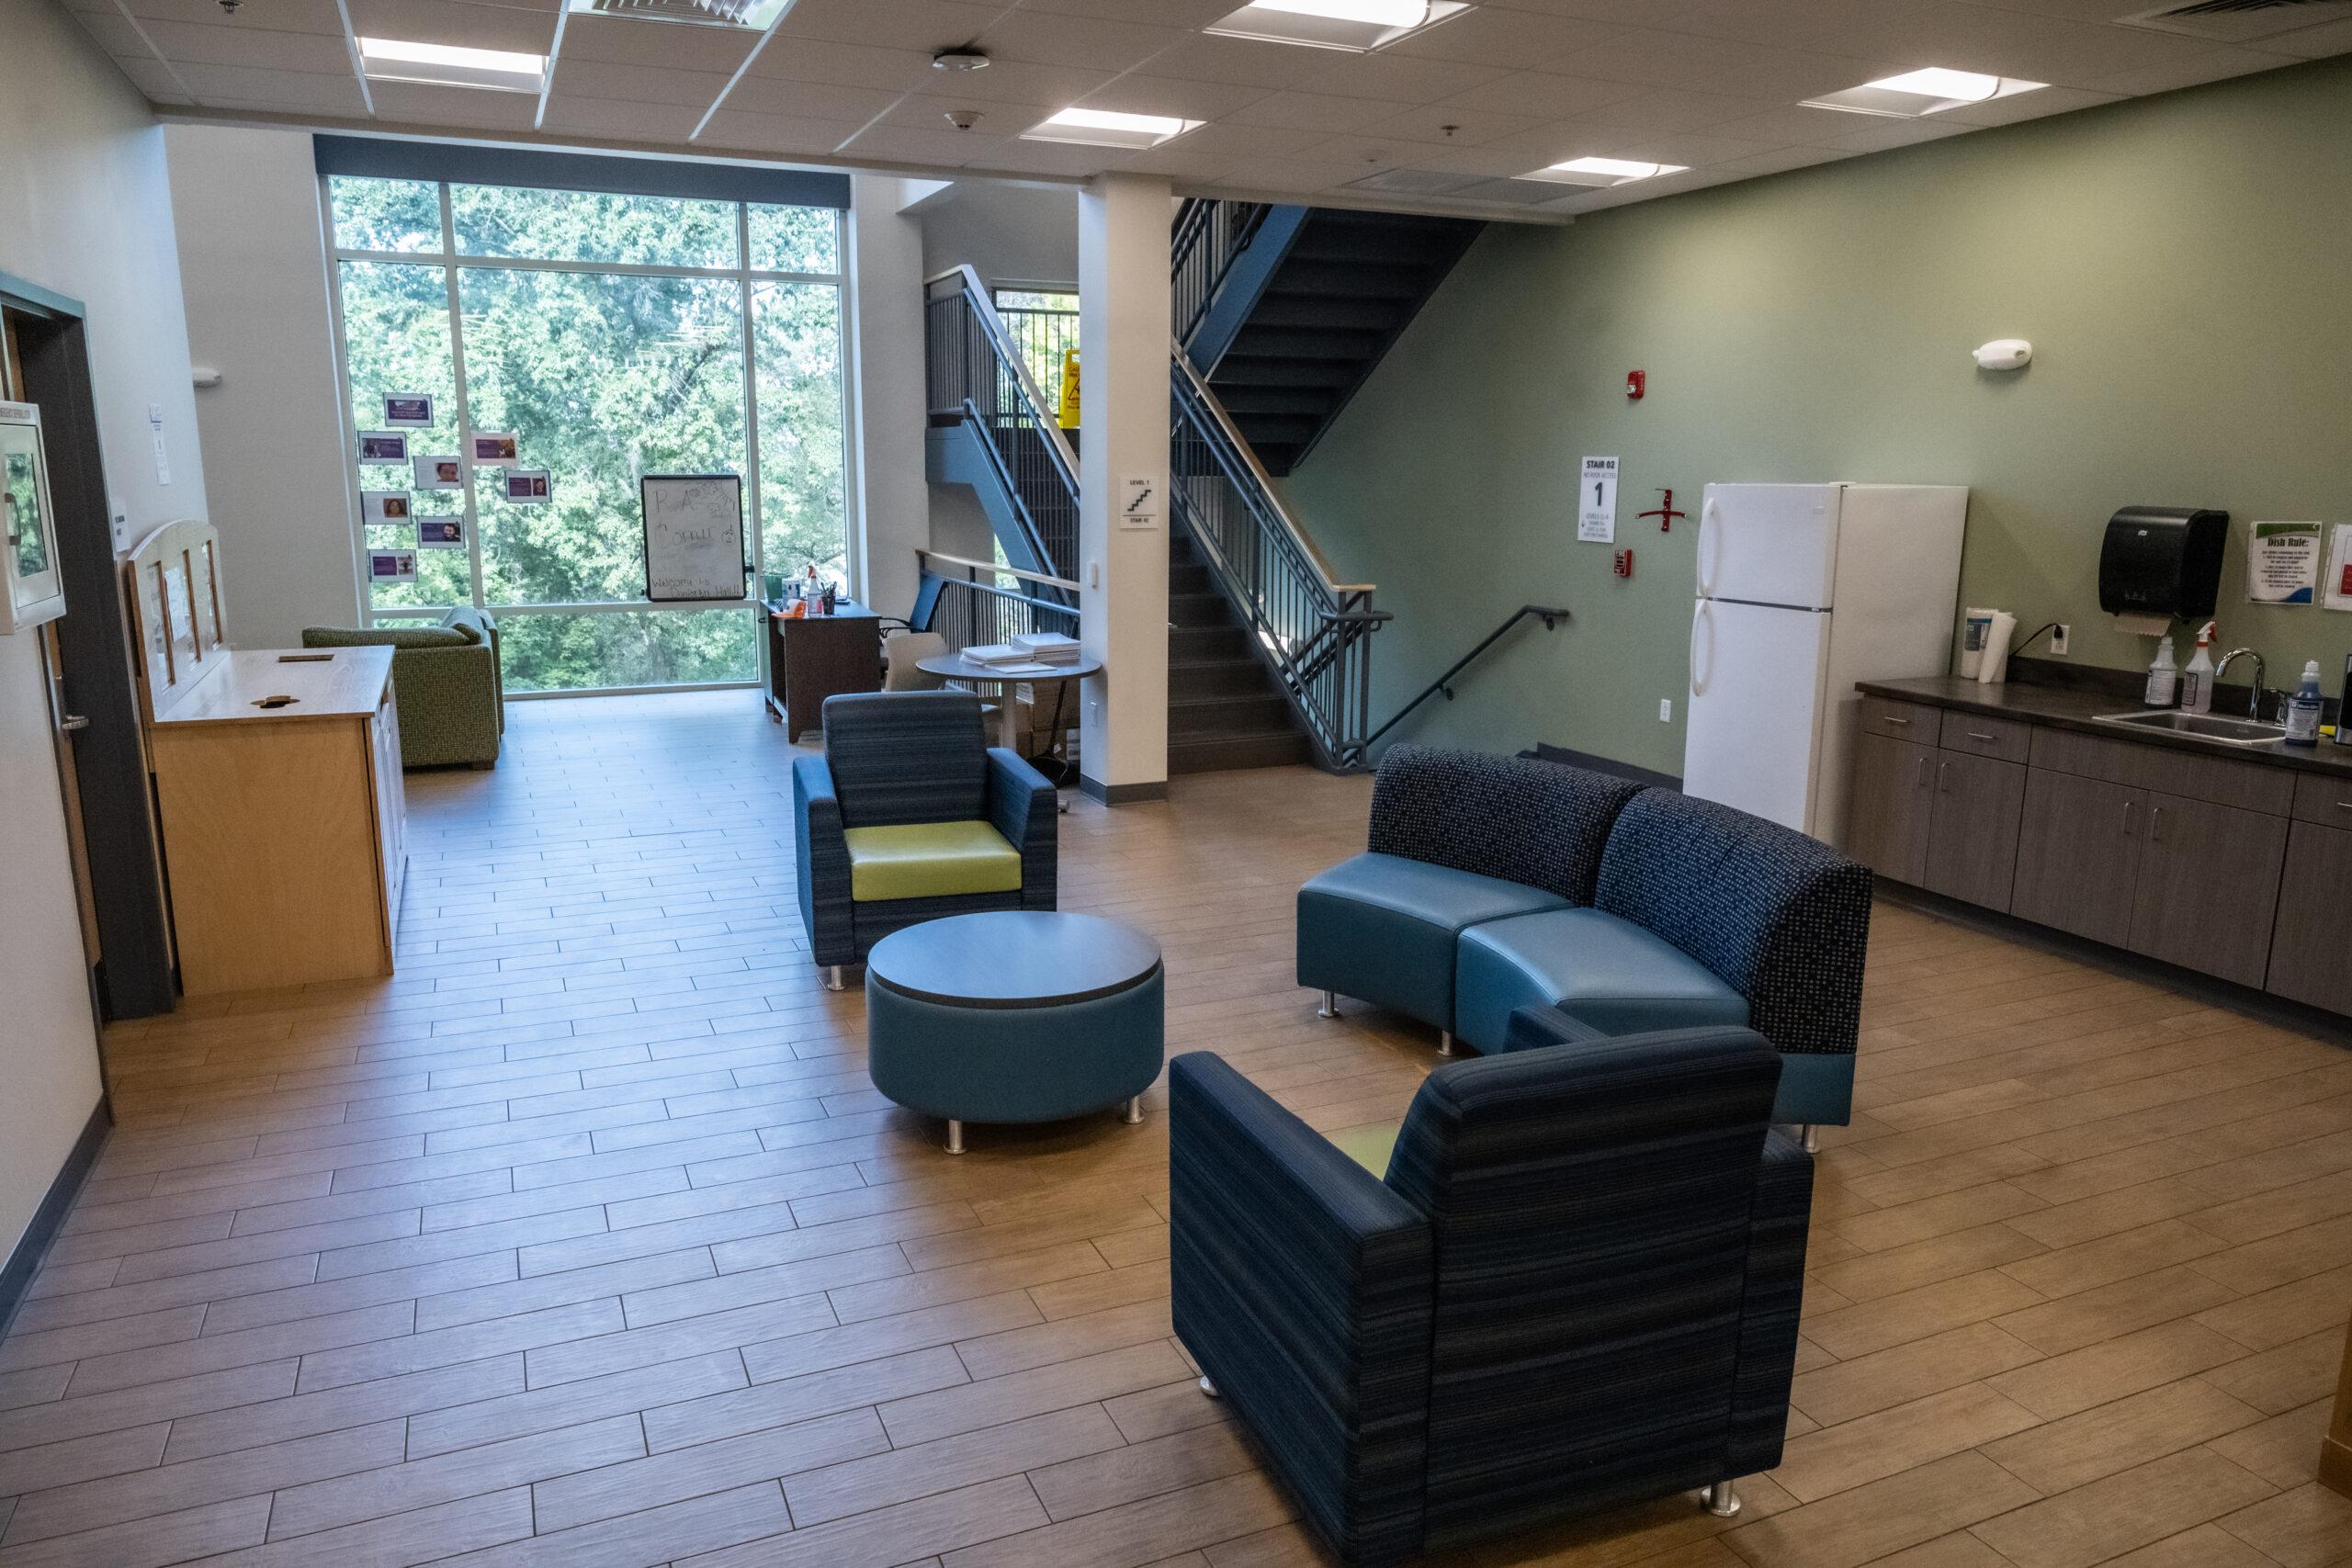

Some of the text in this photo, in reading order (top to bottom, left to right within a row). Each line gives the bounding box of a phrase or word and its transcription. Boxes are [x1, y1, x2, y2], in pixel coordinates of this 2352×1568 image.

[1595, 482, 1603, 506] 1
[2267, 537, 2286, 547] Dish
[651, 577, 710, 587] Welcome to
